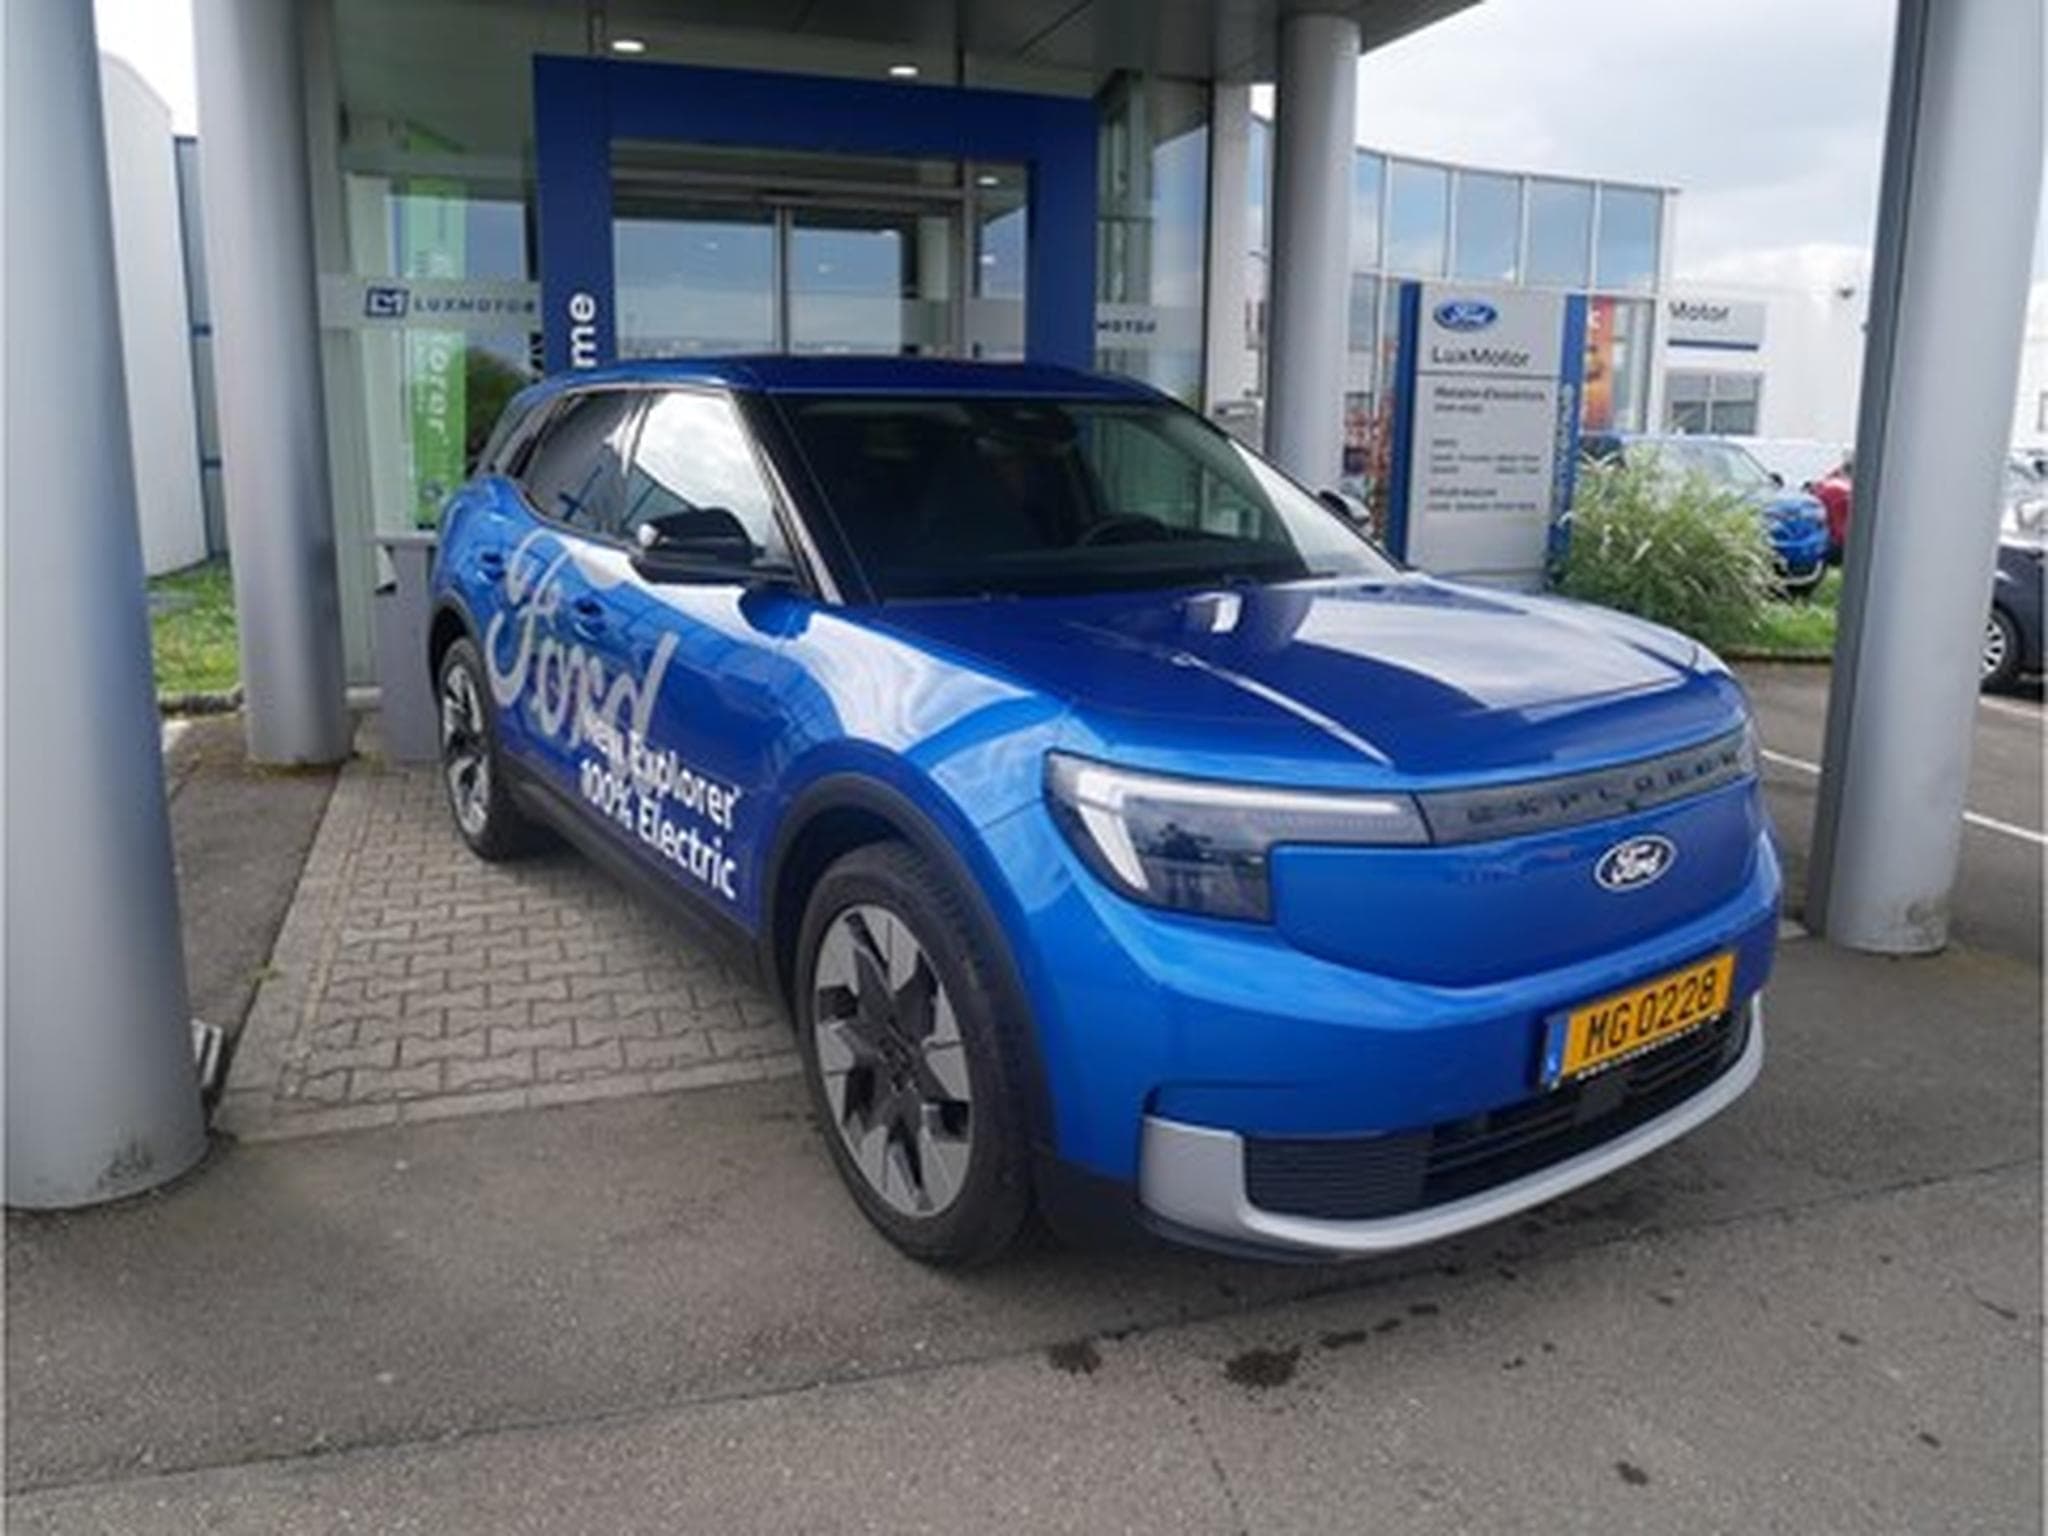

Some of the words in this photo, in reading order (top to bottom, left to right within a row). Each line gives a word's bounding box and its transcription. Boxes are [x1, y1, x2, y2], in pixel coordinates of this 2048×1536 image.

[1432, 346, 1530, 367] LuxMotor
[638, 795, 737, 900] Electric
[1605, 840, 1672, 887] Ford
[1583, 1002, 1631, 1060] MG
[1636, 966, 1717, 1038] 0228
